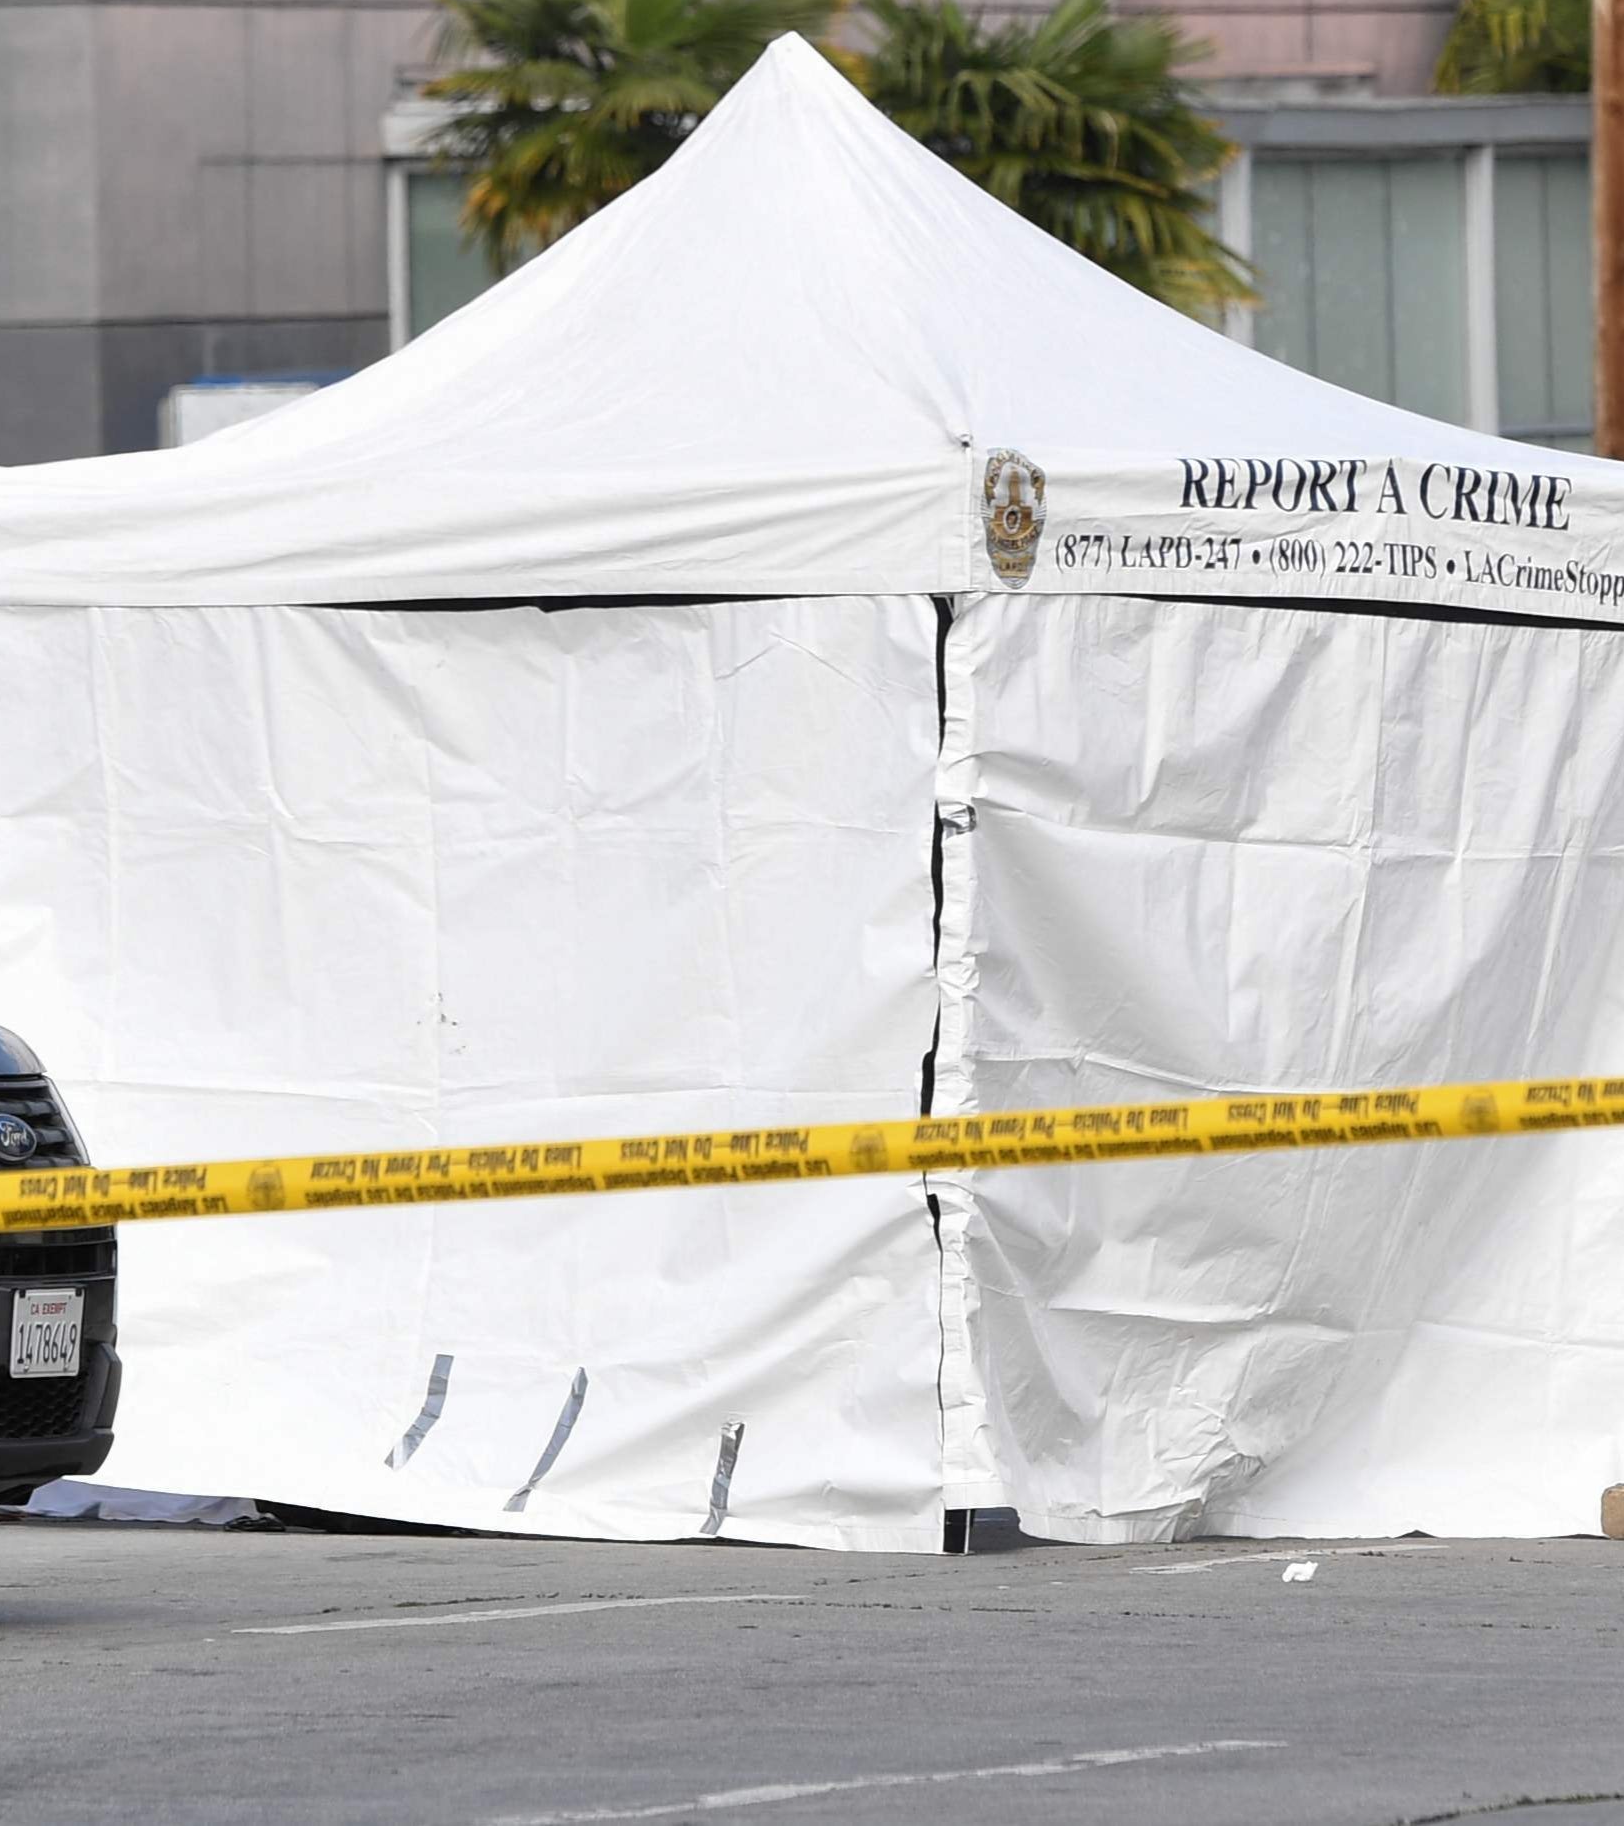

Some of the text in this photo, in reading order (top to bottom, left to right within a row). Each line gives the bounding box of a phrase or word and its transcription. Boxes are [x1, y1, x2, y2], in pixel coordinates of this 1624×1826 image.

[1177, 457, 1572, 530] REPORT A CRIME
[1055, 533, 1113, 574] (877)
[1121, 535, 1242, 570] LAPD-247
[1269, 537, 1327, 579] (800)
[1335, 541, 1438, 579] 222-TIPS
[20, 1176, 58, 1202] Cross
[64, 1176, 86, 1197] Not
[163, 1168, 207, 1192] Police
[31, 1302, 67, 1315] CA EXEMPT
[17, 1323, 77, 1364] 1478649
